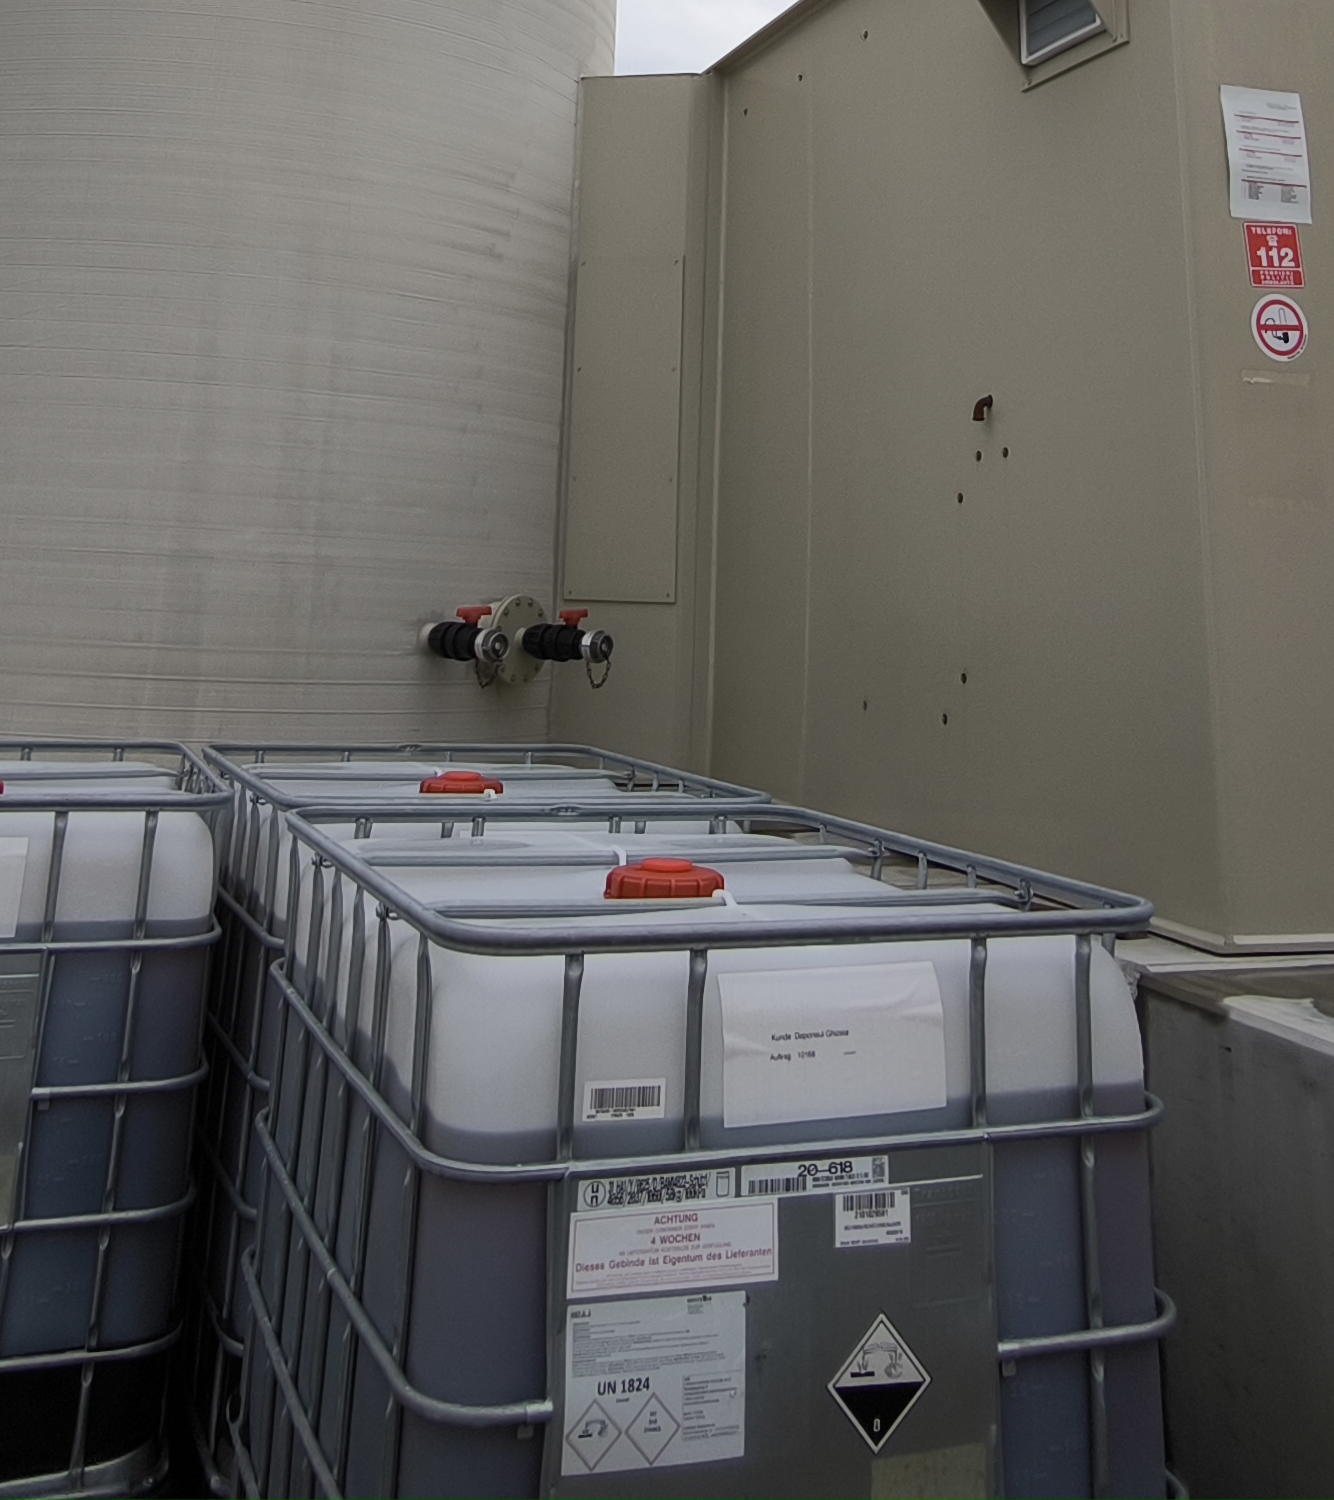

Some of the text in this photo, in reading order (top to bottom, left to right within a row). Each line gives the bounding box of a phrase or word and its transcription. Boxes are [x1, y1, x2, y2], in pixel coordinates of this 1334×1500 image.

[1256, 246, 1295, 267] 112
[771, 1033, 792, 1041] Kunde
[654, 1213, 699, 1225] ACHTUNG
[650, 1233, 701, 1245] 4 WOCHEN
[575, 1261, 605, 1273] Dieses
[608, 1258, 645, 1269] Gebinde
[662, 1254, 703, 1266] Eigentum
[706, 1251, 722, 1261] des
[725, 1248, 772, 1260] Lieferanten
[597, 1376, 650, 1396] UN 1824
